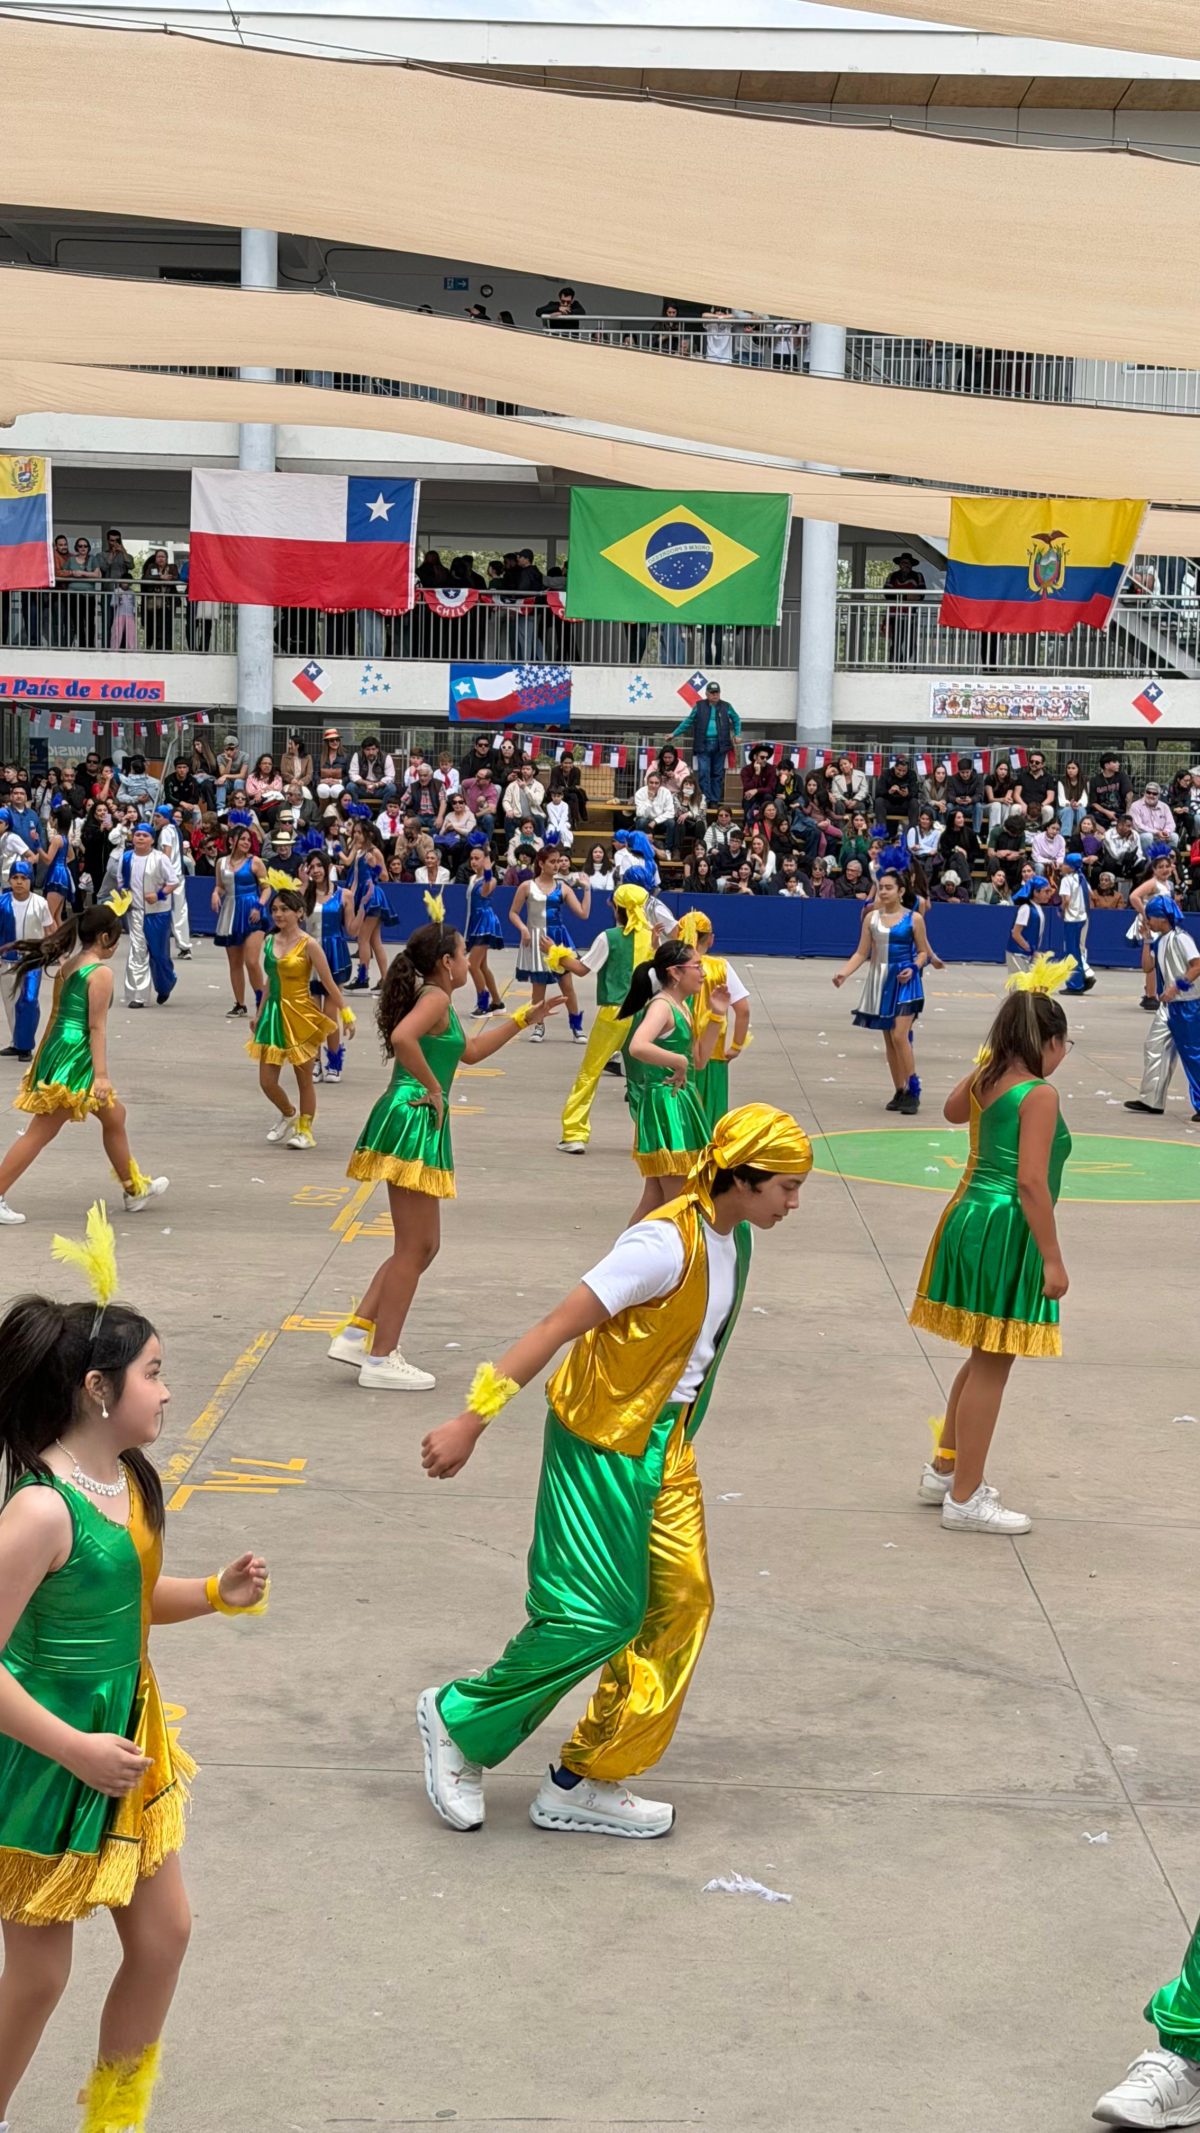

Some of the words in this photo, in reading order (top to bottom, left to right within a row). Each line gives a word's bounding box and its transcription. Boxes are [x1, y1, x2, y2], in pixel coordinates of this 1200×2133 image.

[436, 604, 469, 617] CHILE
[12, 679, 59, 697] País
[65, 680, 91, 698] de
[101, 682, 161, 700] todos
